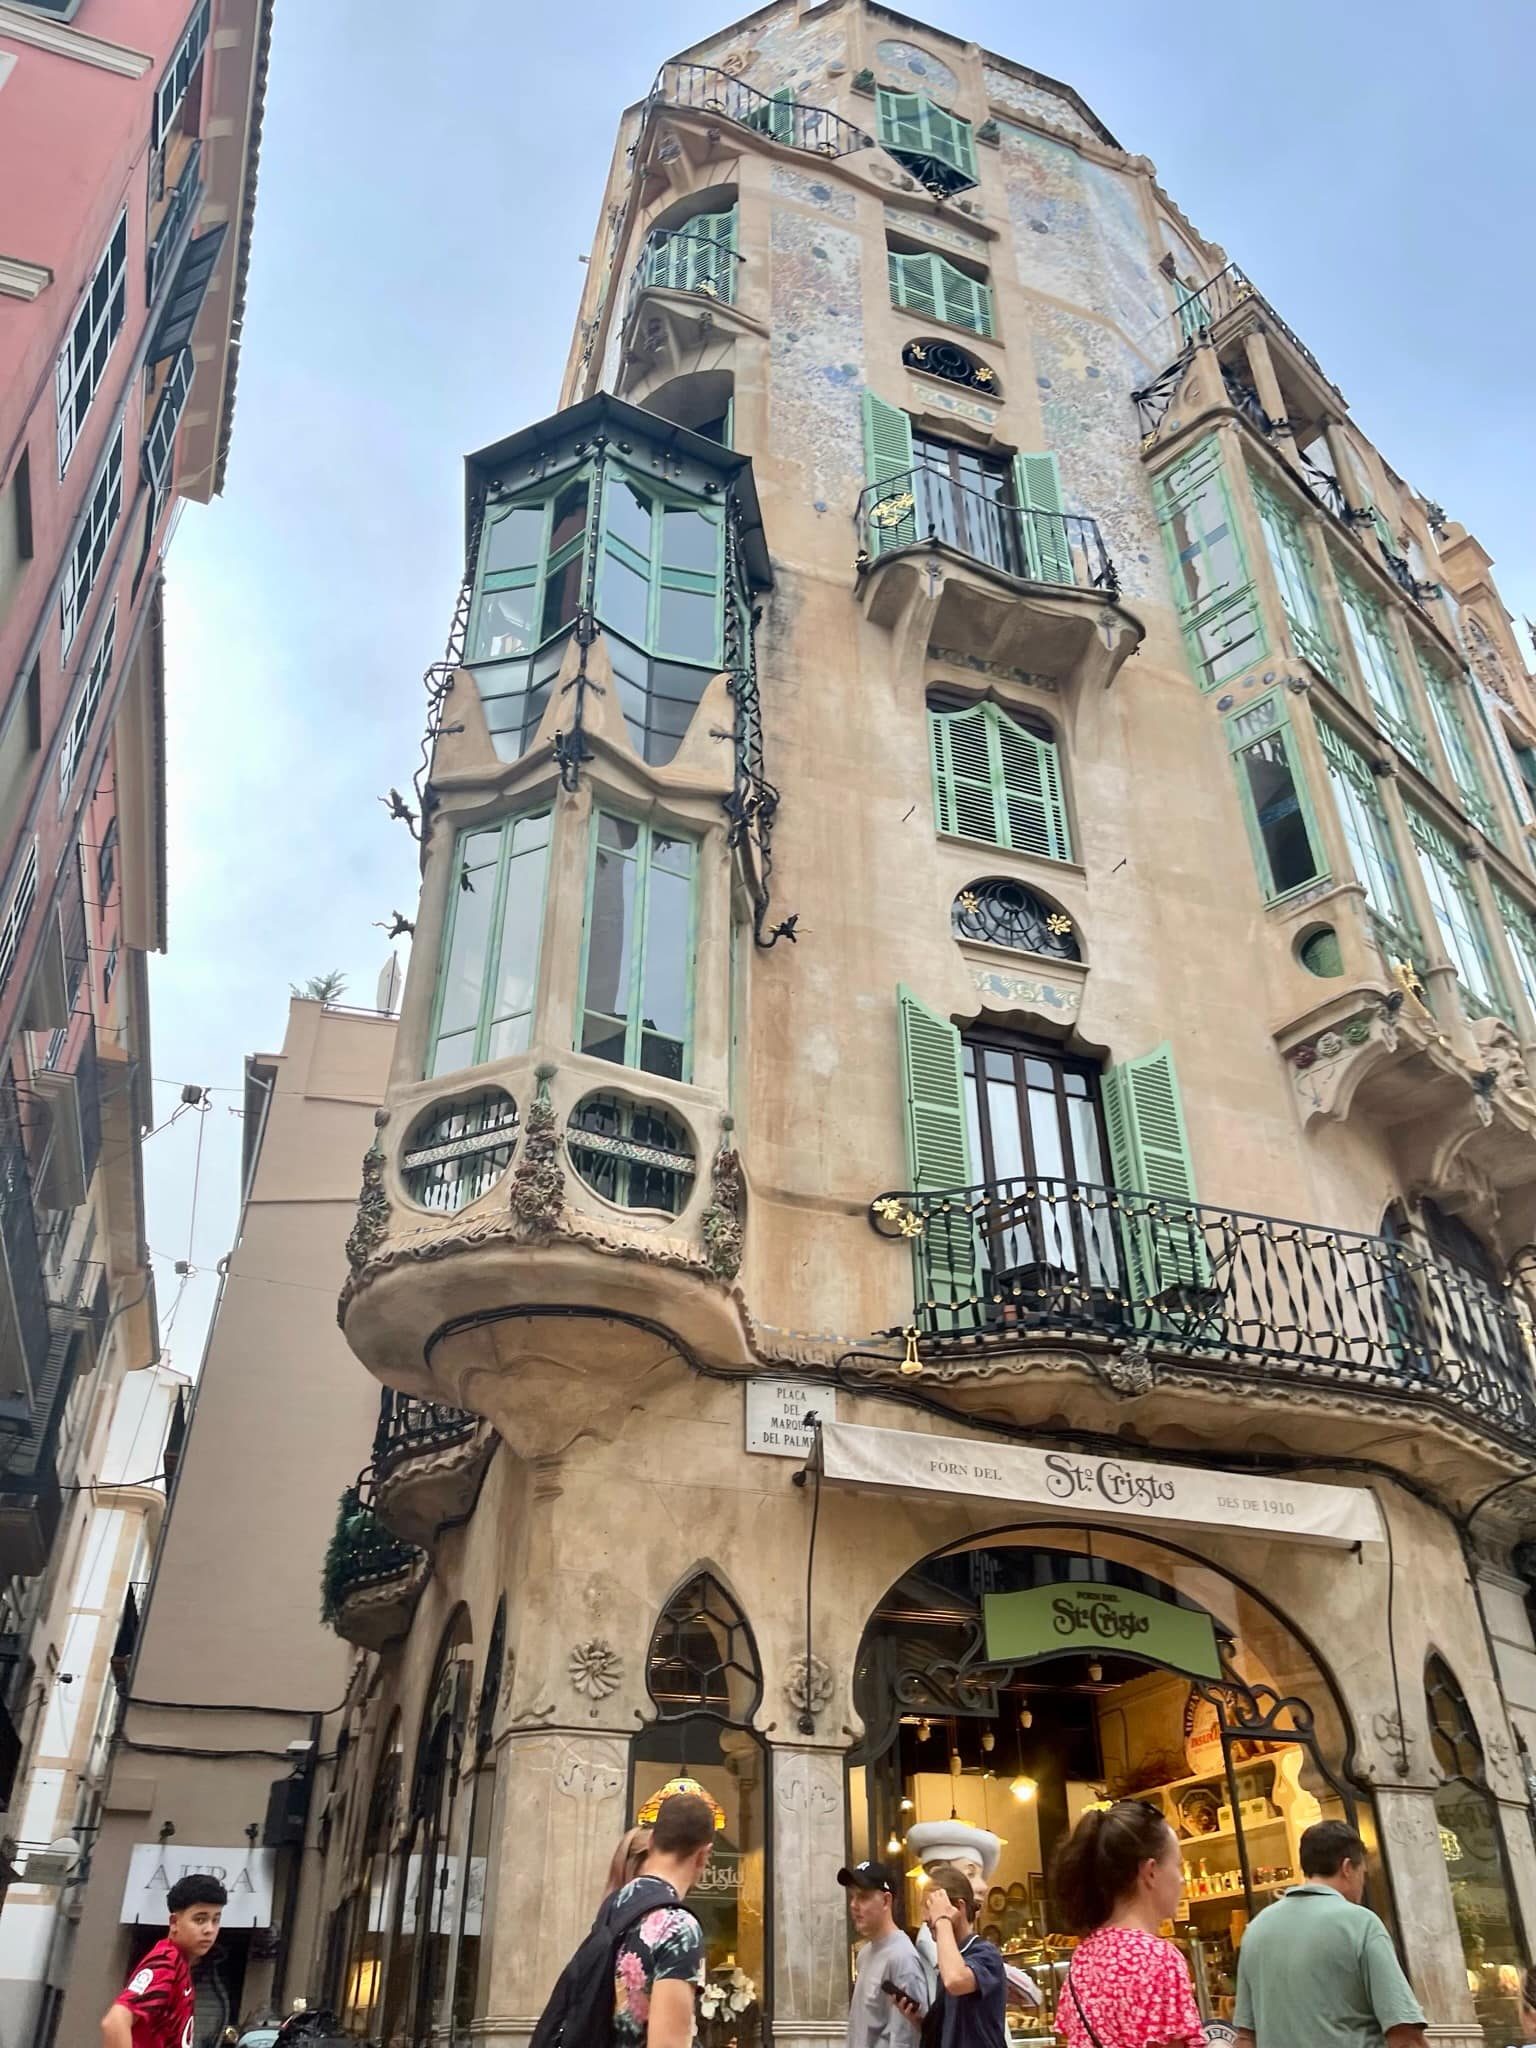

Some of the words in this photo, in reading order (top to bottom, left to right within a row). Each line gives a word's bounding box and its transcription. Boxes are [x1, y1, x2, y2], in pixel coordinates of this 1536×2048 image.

[783, 1403, 801, 1416] DEL
[762, 1431, 780, 1445] DEL
[930, 1460, 969, 1477] FORN
[974, 1466, 1002, 1481] DEL
[1096, 1461, 1176, 1508] Cristo
[1216, 1496, 1240, 1509] DES
[1242, 1499, 1261, 1512] DE
[1262, 1499, 1296, 1516] 1910
[1090, 1602, 1150, 1640] Cristo
